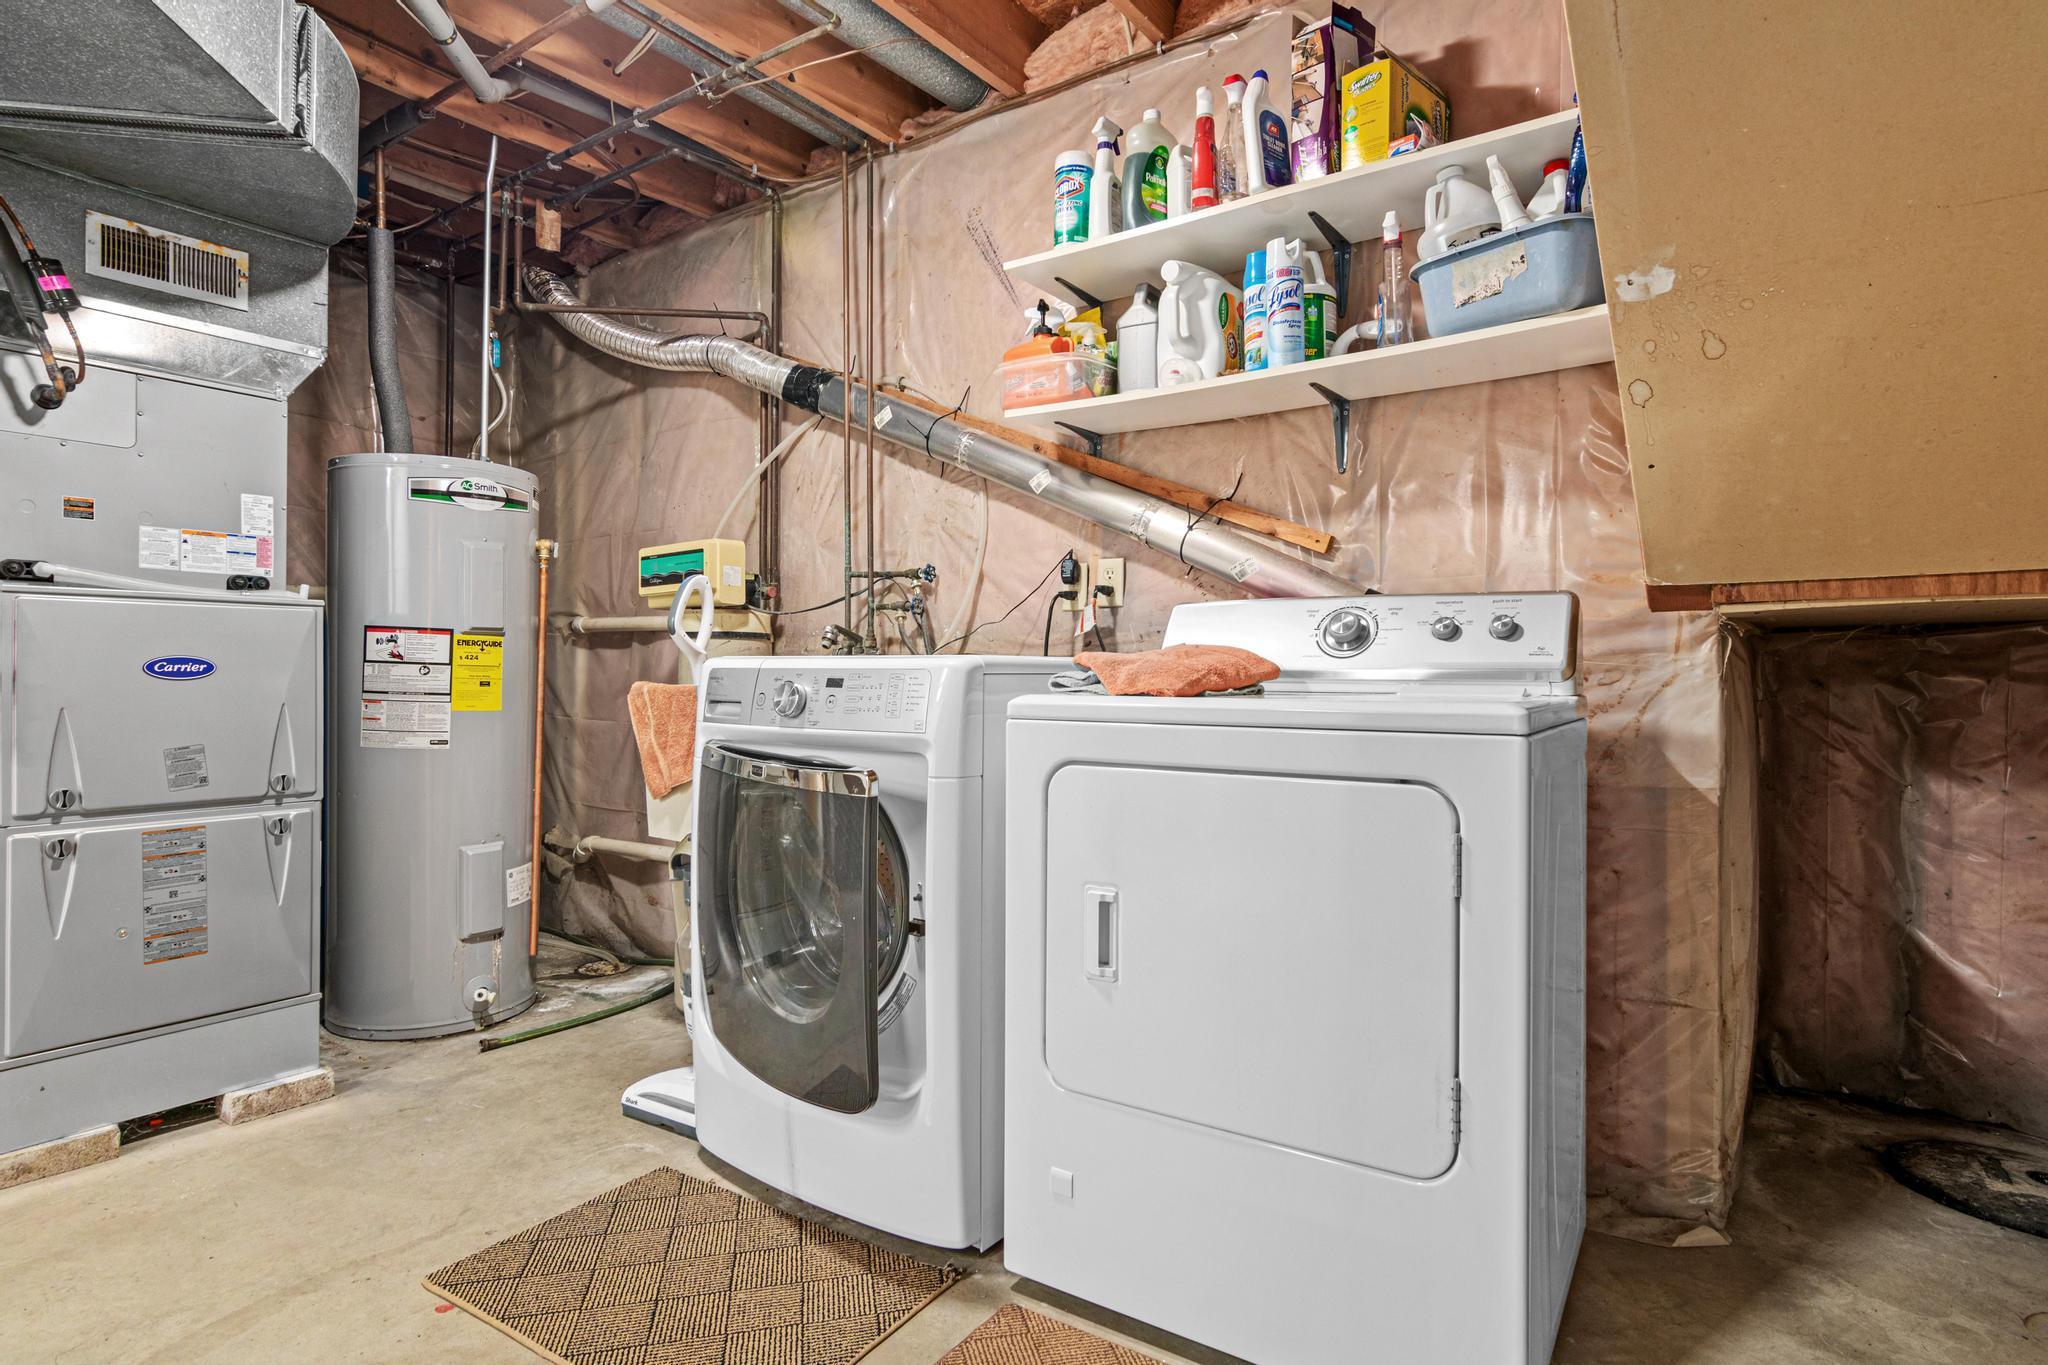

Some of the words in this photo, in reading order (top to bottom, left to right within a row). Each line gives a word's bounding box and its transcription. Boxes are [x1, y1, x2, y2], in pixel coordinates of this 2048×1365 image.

[1349, 71, 1381, 93] Swiffer
[1269, 284, 1301, 309] Lysol
[474, 482, 498, 493] Smith
[154, 661, 207, 672] Carrier
